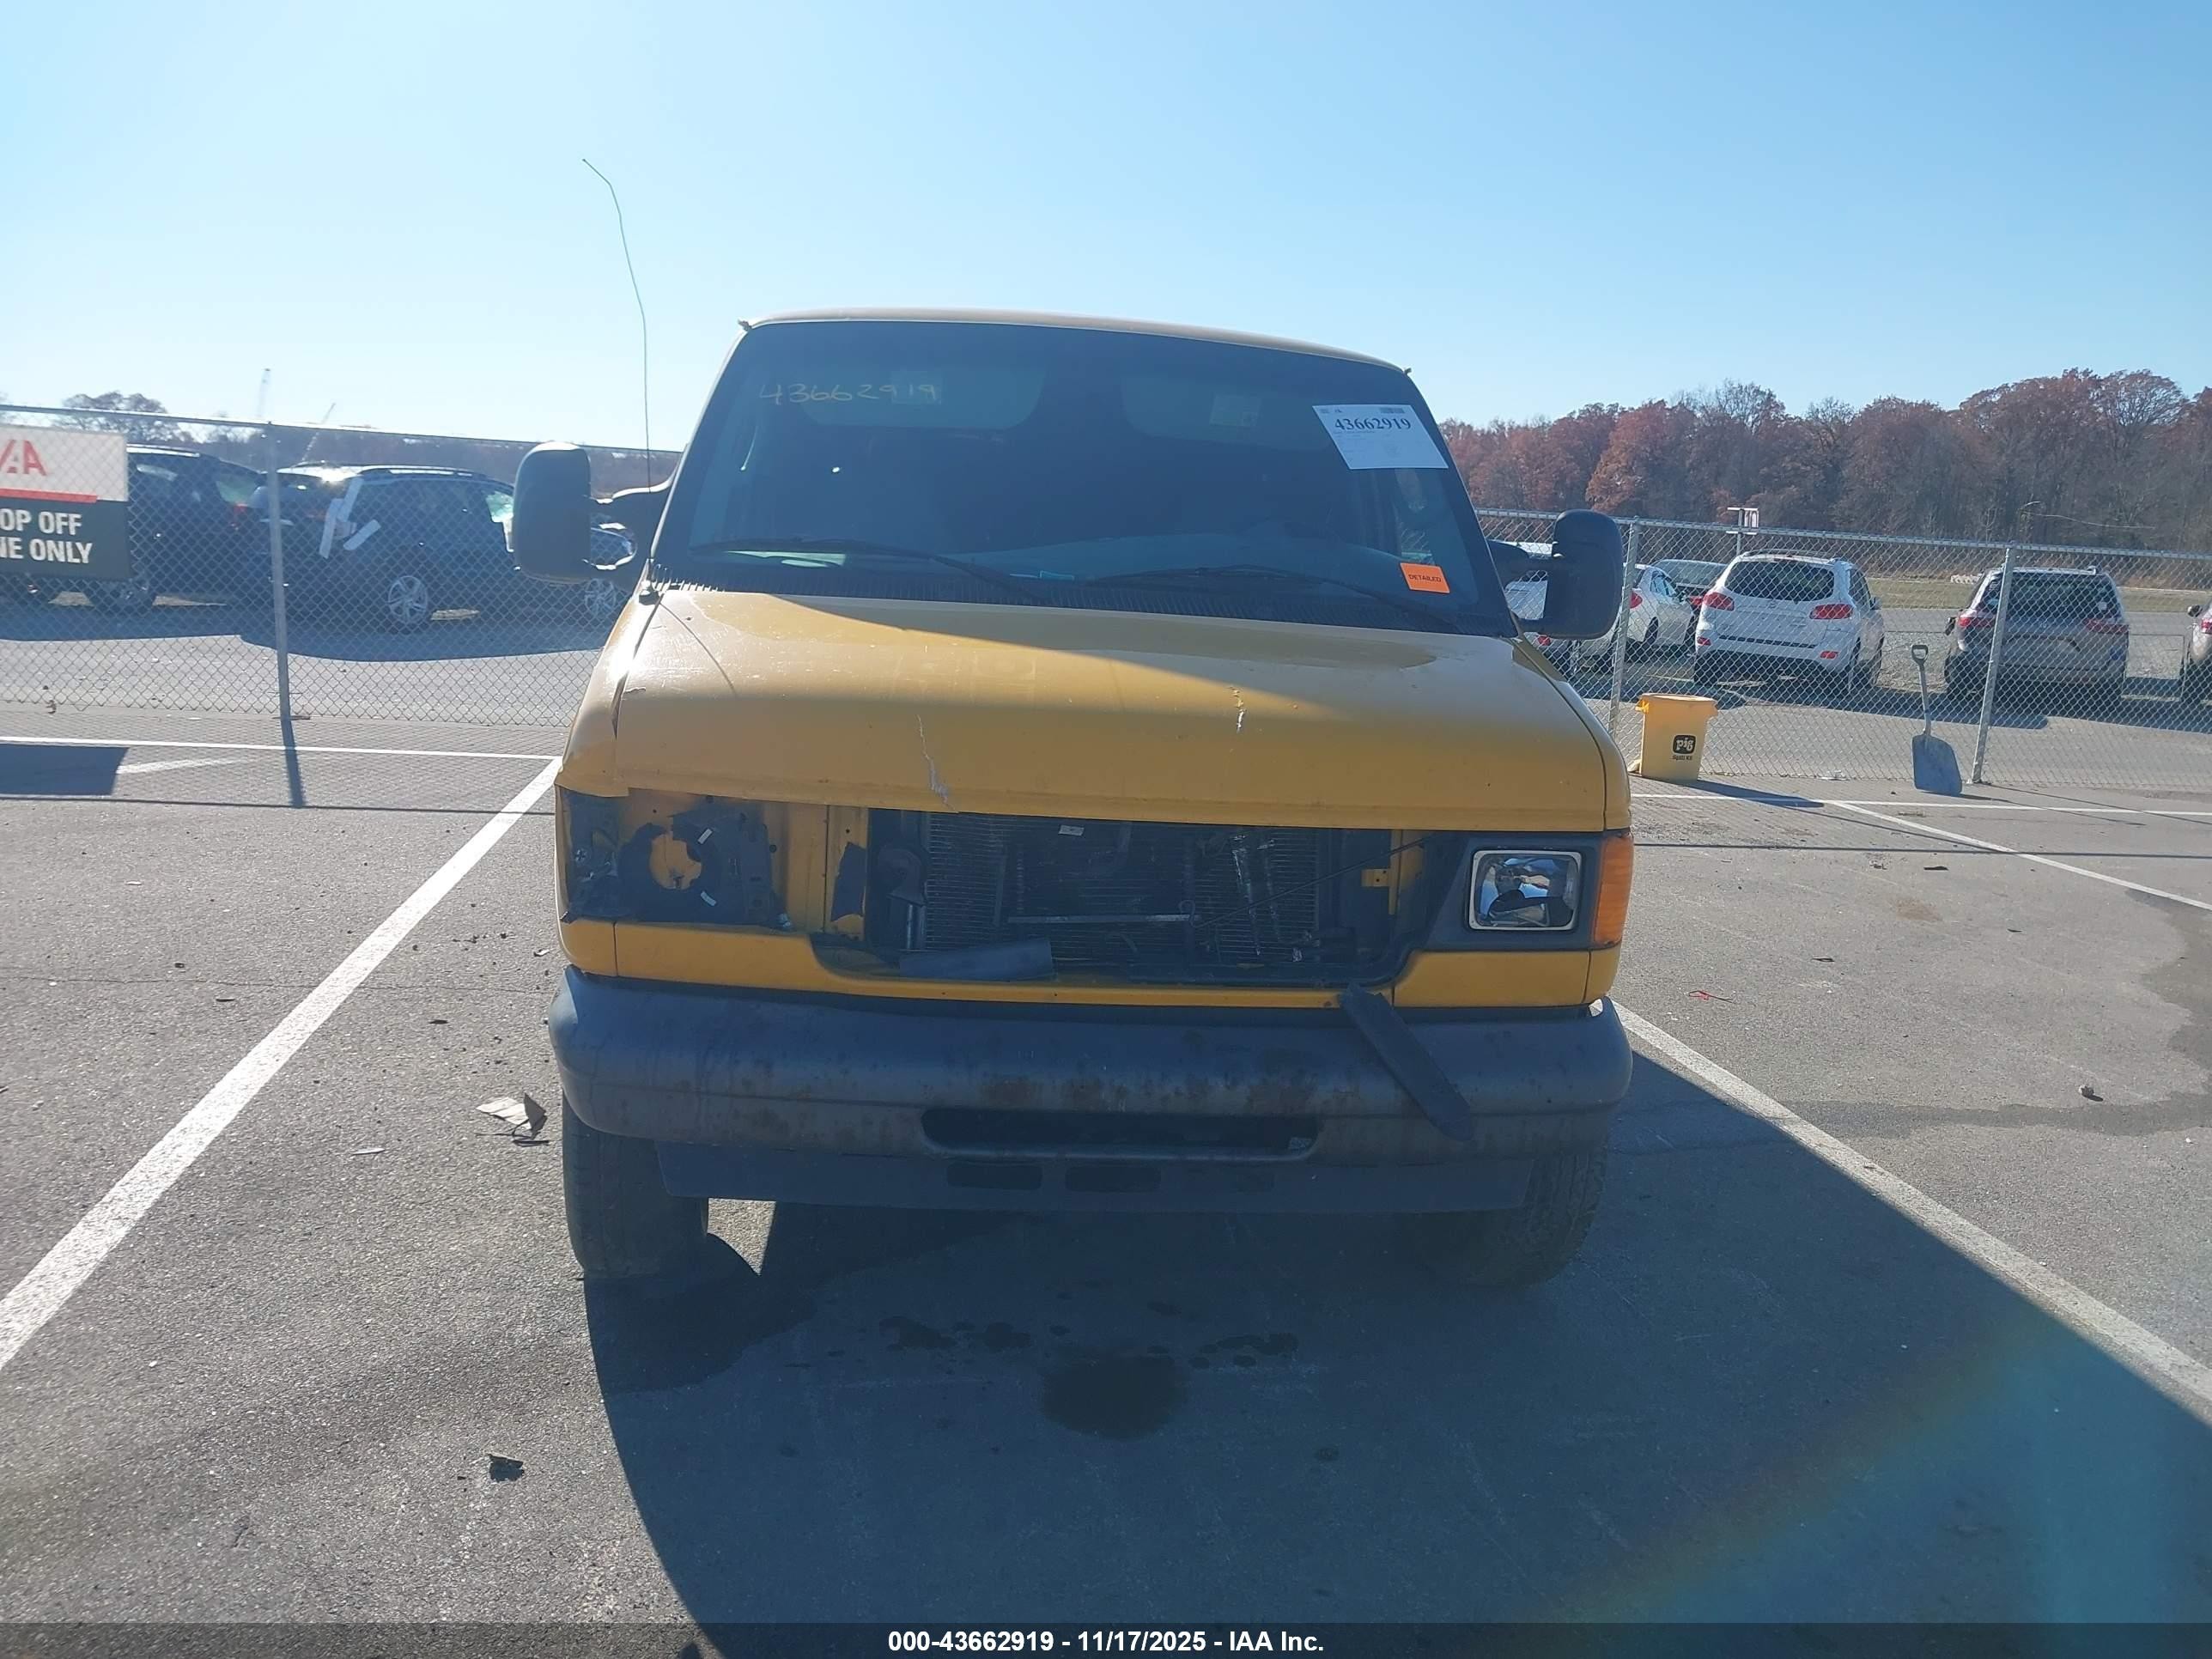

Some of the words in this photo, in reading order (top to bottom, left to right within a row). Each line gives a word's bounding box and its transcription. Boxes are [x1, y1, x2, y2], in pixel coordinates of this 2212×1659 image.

[759, 383, 938, 405] 43662919
[1334, 417, 1412, 430] 43662919
[0, 507, 32, 532] OP
[38, 511, 82, 536] OFF
[29, 538, 93, 564] ONLY
[1408, 574, 1442, 583] DETAILED
[1675, 737, 1694, 751] pig
